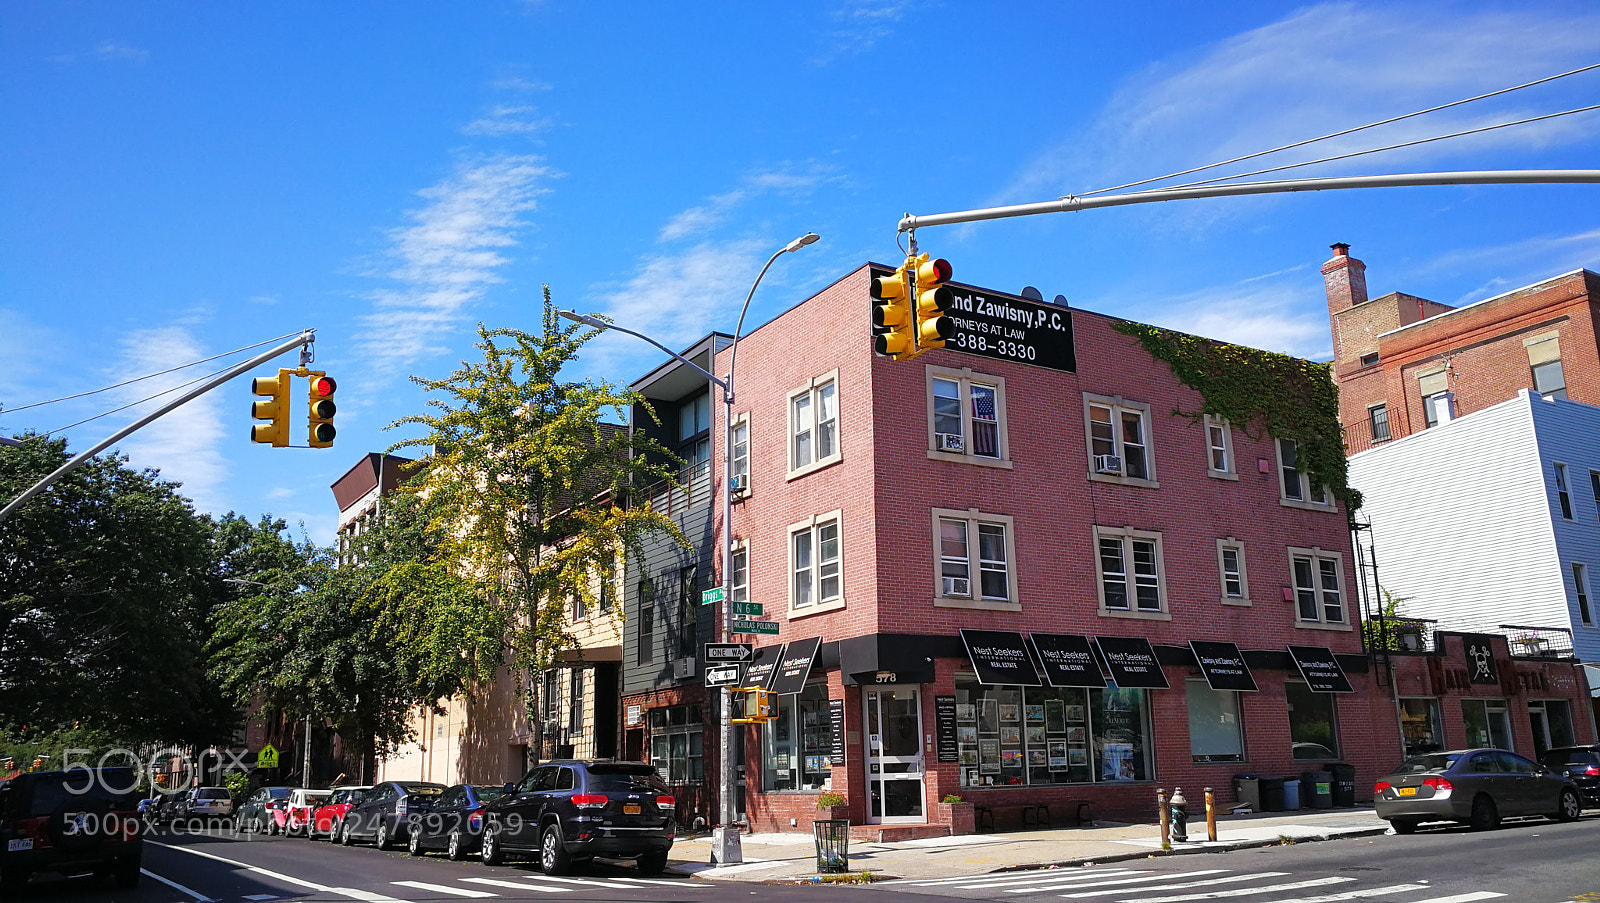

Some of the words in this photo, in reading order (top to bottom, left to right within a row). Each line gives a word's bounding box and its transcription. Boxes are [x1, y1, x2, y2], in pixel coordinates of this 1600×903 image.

[951, 294, 973, 313] nd
[990, 324, 1003, 336] AT
[1004, 326, 1025, 341] LAW
[702, 590, 718, 602] Driggs
[736, 603, 742, 614] N
[745, 603, 751, 614] 6
[733, 621, 756, 630] NICHOLAS
[712, 649, 726, 657] ONE
[731, 648, 746, 657] WAY
[973, 646, 992, 656] Nest
[992, 647, 1024, 658] Seekers
[1042, 650, 1061, 659] Nest
[1061, 650, 1090, 660] Seekers
[1108, 652, 1128, 661] Nest
[1127, 652, 1152, 662] Seekers
[709, 672, 720, 681] ONE
[723, 670, 735, 679] WAY
[875, 672, 897, 684] 578
